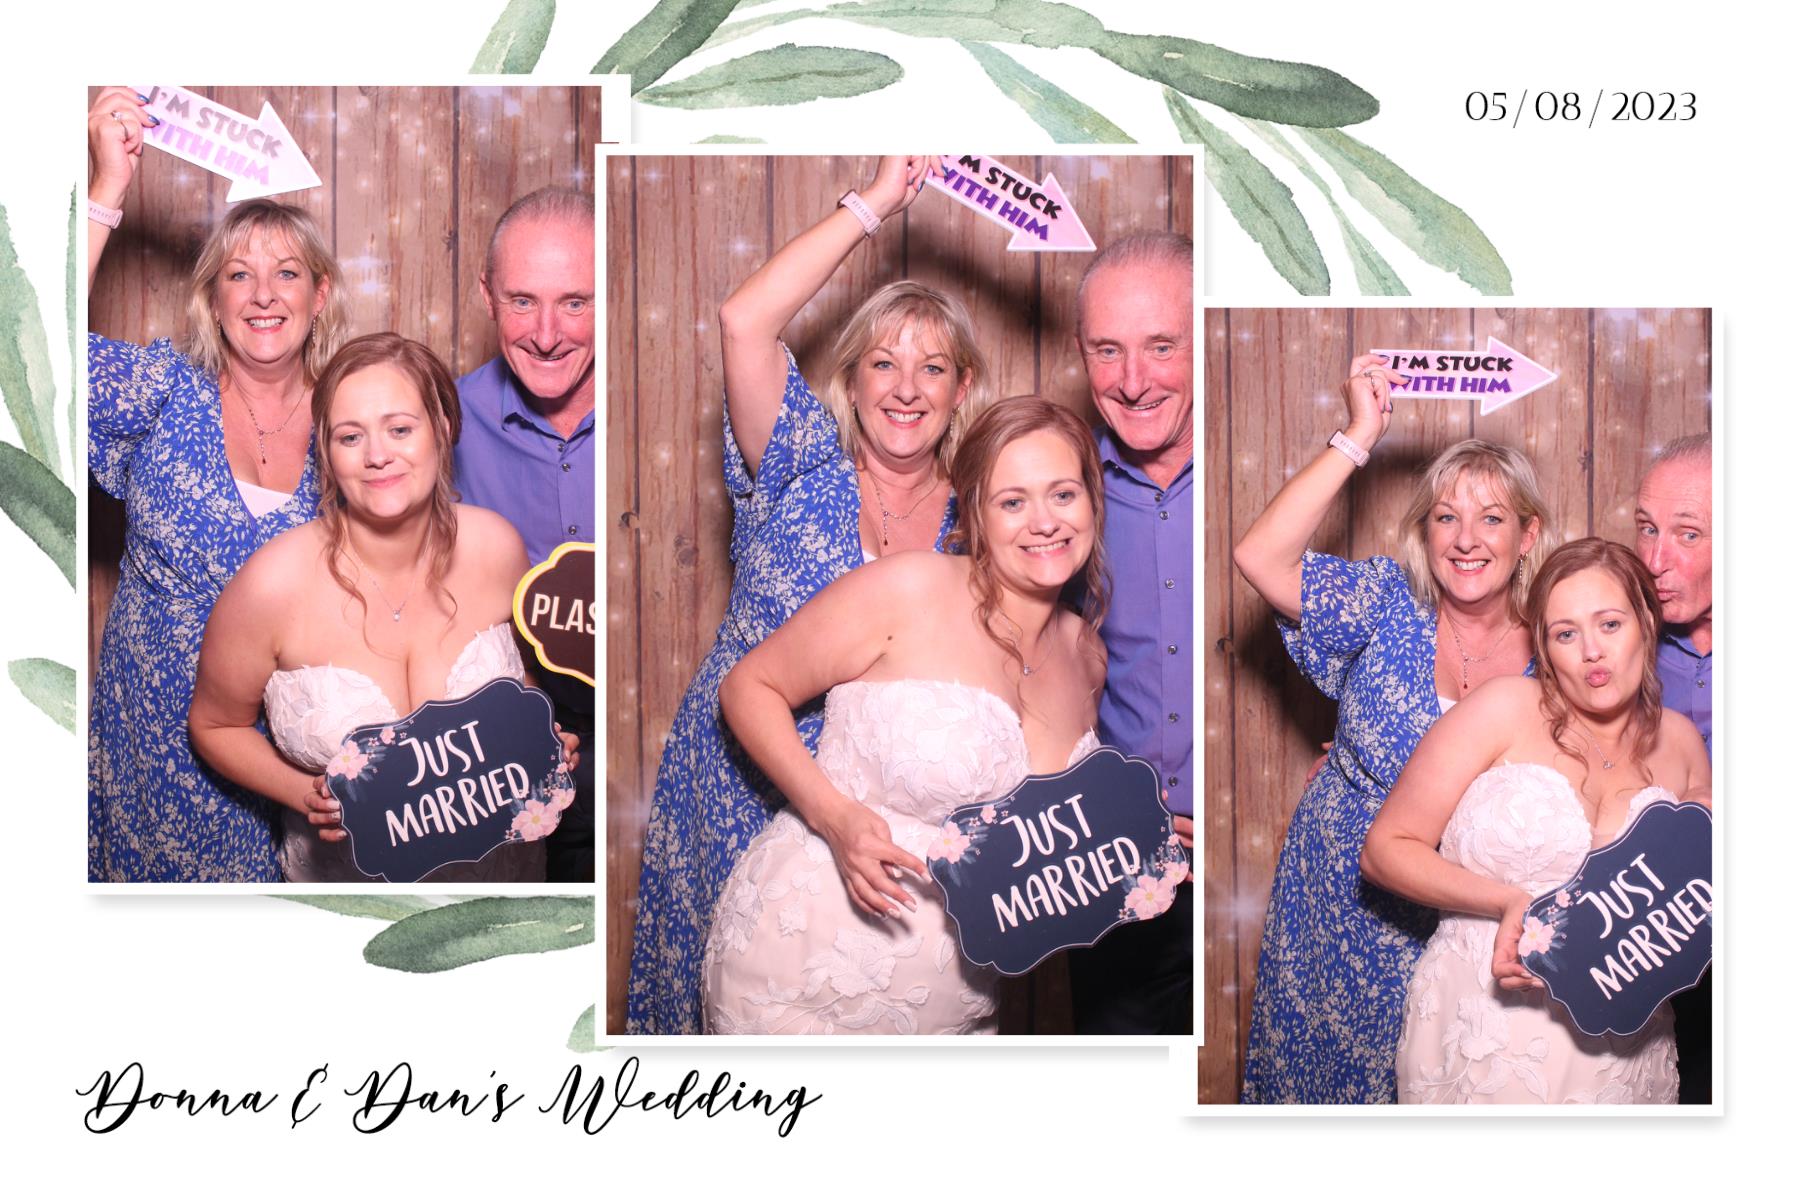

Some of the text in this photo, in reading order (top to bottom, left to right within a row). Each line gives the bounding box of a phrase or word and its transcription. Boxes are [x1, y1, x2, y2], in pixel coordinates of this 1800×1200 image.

[149, 86, 282, 159] I'M STUCK
[213, 145, 270, 185] HIM
[985, 166, 1063, 220] STUCK
[998, 201, 1049, 241] HIM
[1391, 355, 1513, 372] I'M STUCK
[1459, 376, 1513, 394] HIM
[398, 720, 486, 787] JUST
[385, 762, 530, 848] MARRIED
[1000, 793, 1092, 868] JUST
[991, 836, 1141, 933] MARRIED
[1576, 852, 1665, 939] JUST
[1589, 878, 1713, 1001] MARRIED
